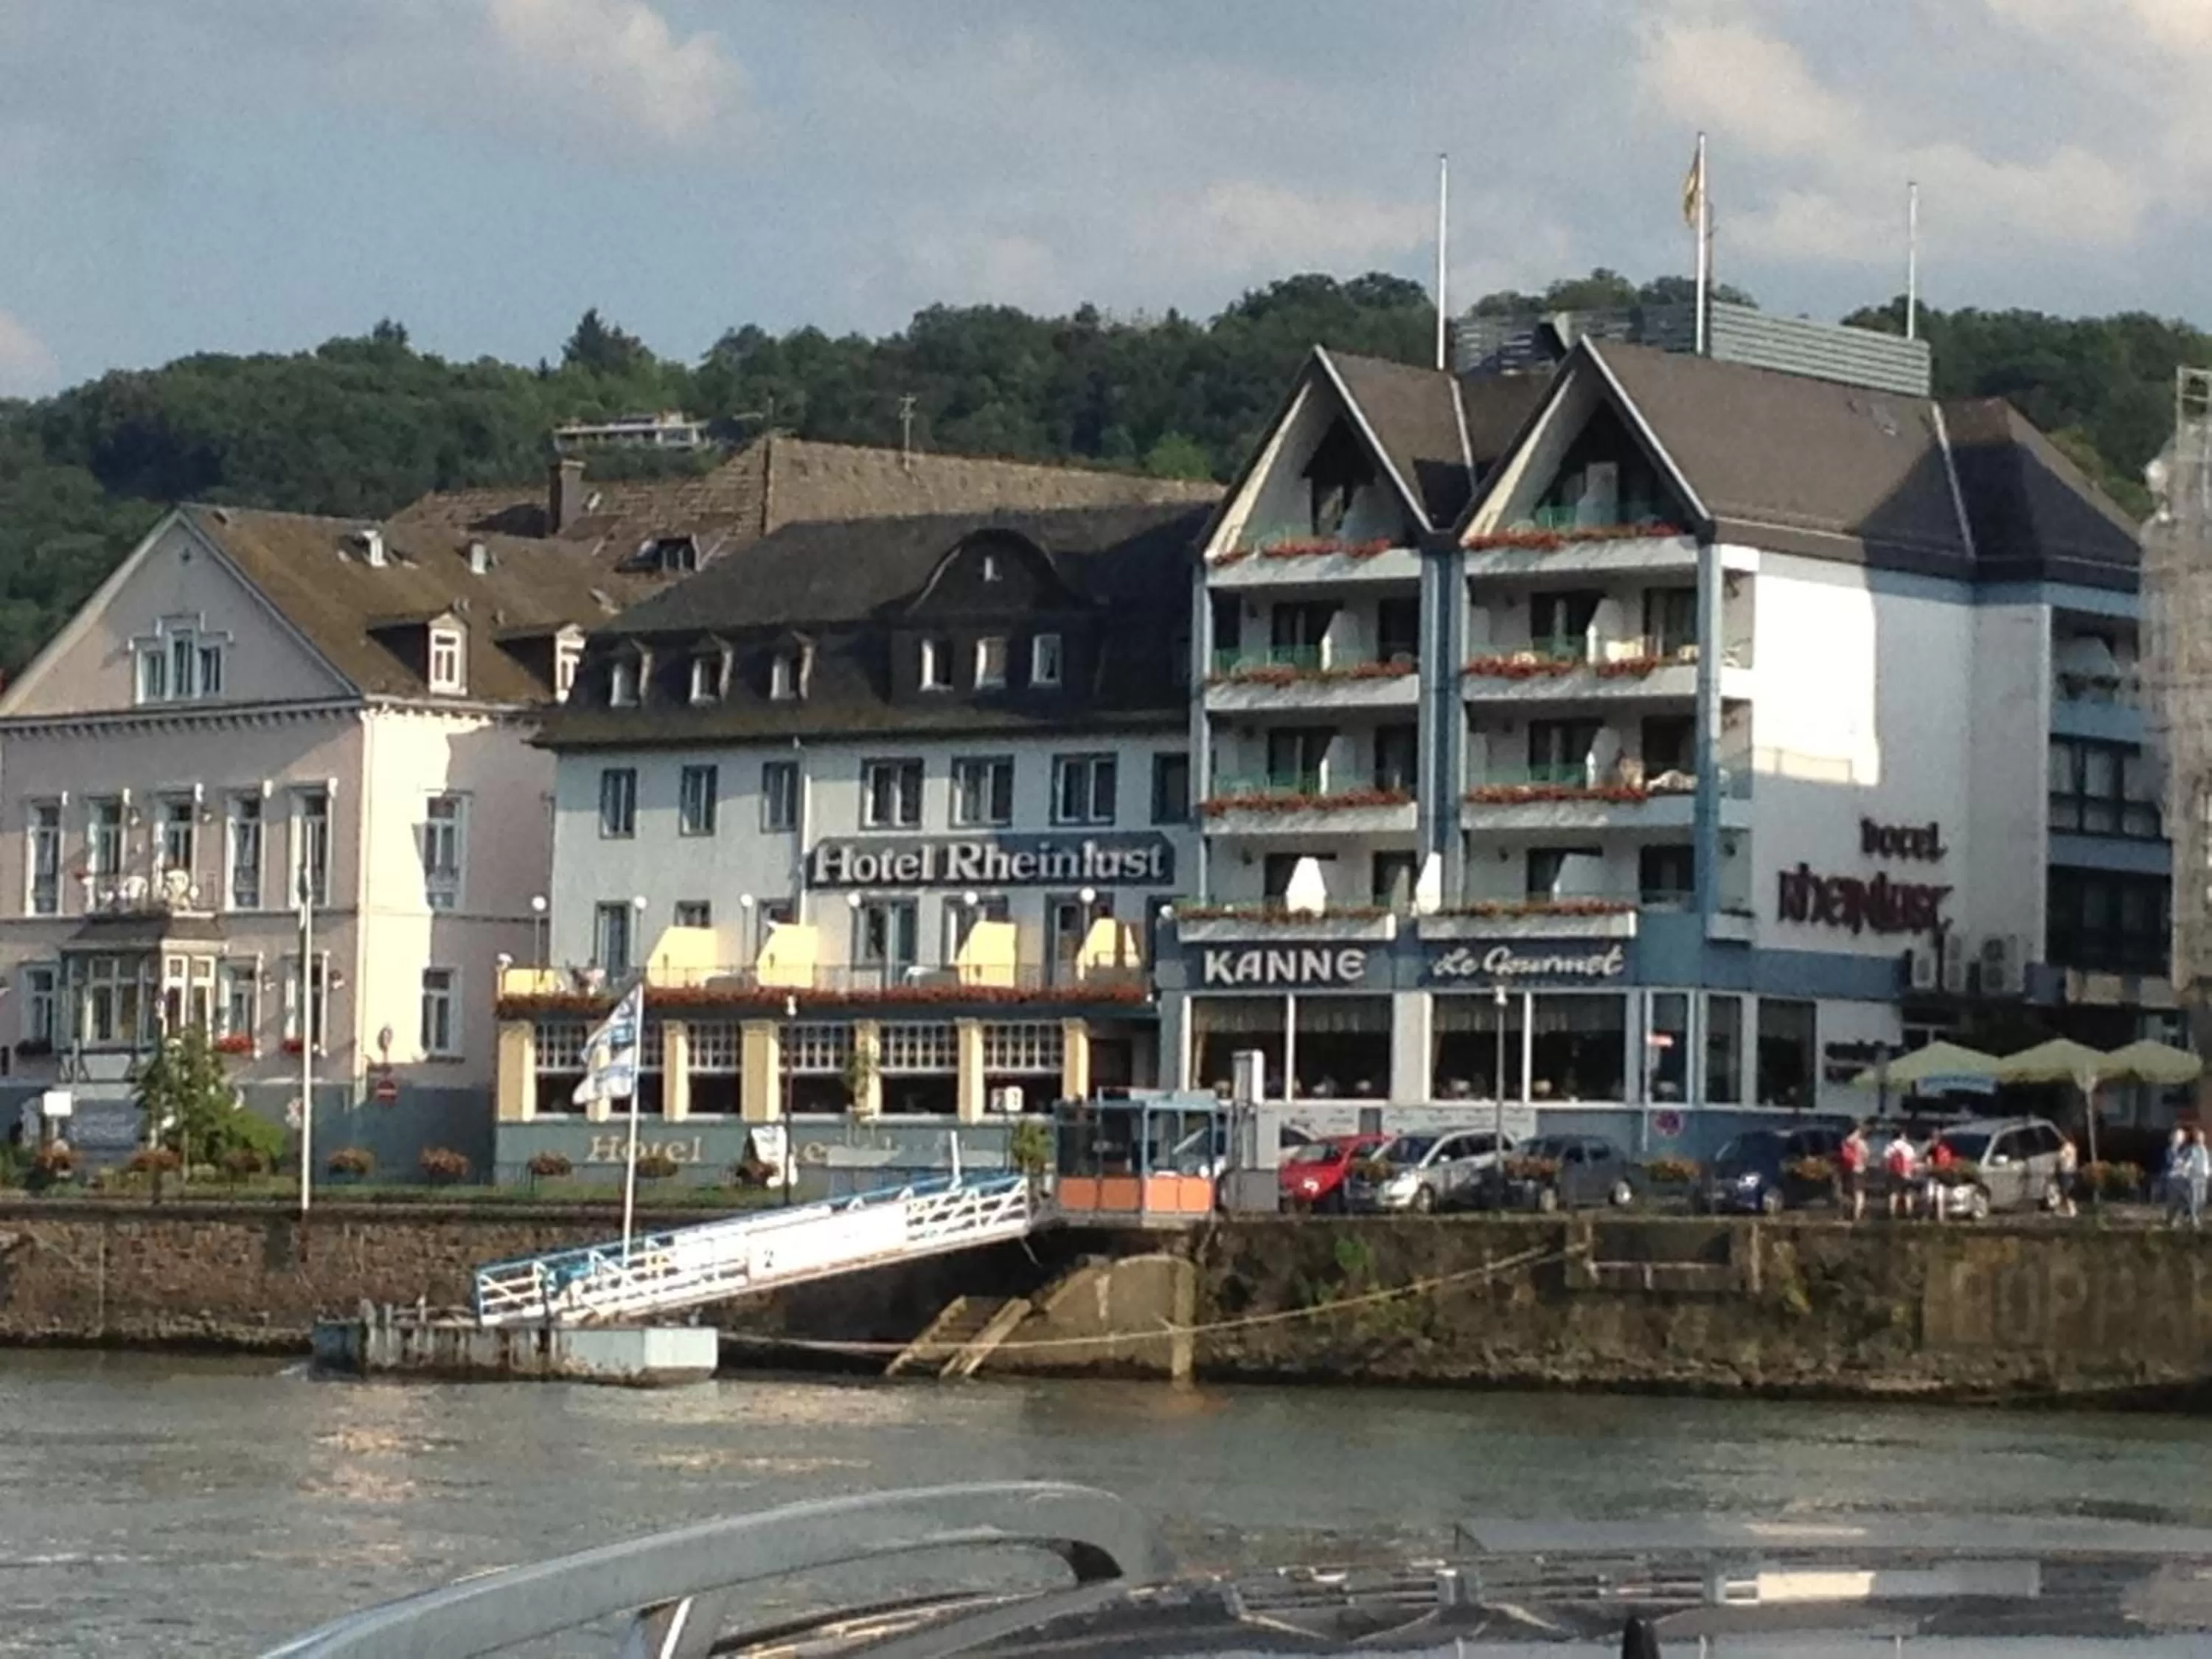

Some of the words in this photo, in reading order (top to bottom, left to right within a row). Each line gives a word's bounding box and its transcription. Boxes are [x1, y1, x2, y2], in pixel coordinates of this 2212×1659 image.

[814, 843, 936, 883] Hotel
[944, 840, 1164, 880] Rheinlust
[1203, 948, 1366, 984] KANNE
[587, 1135, 701, 1163] Hotel
